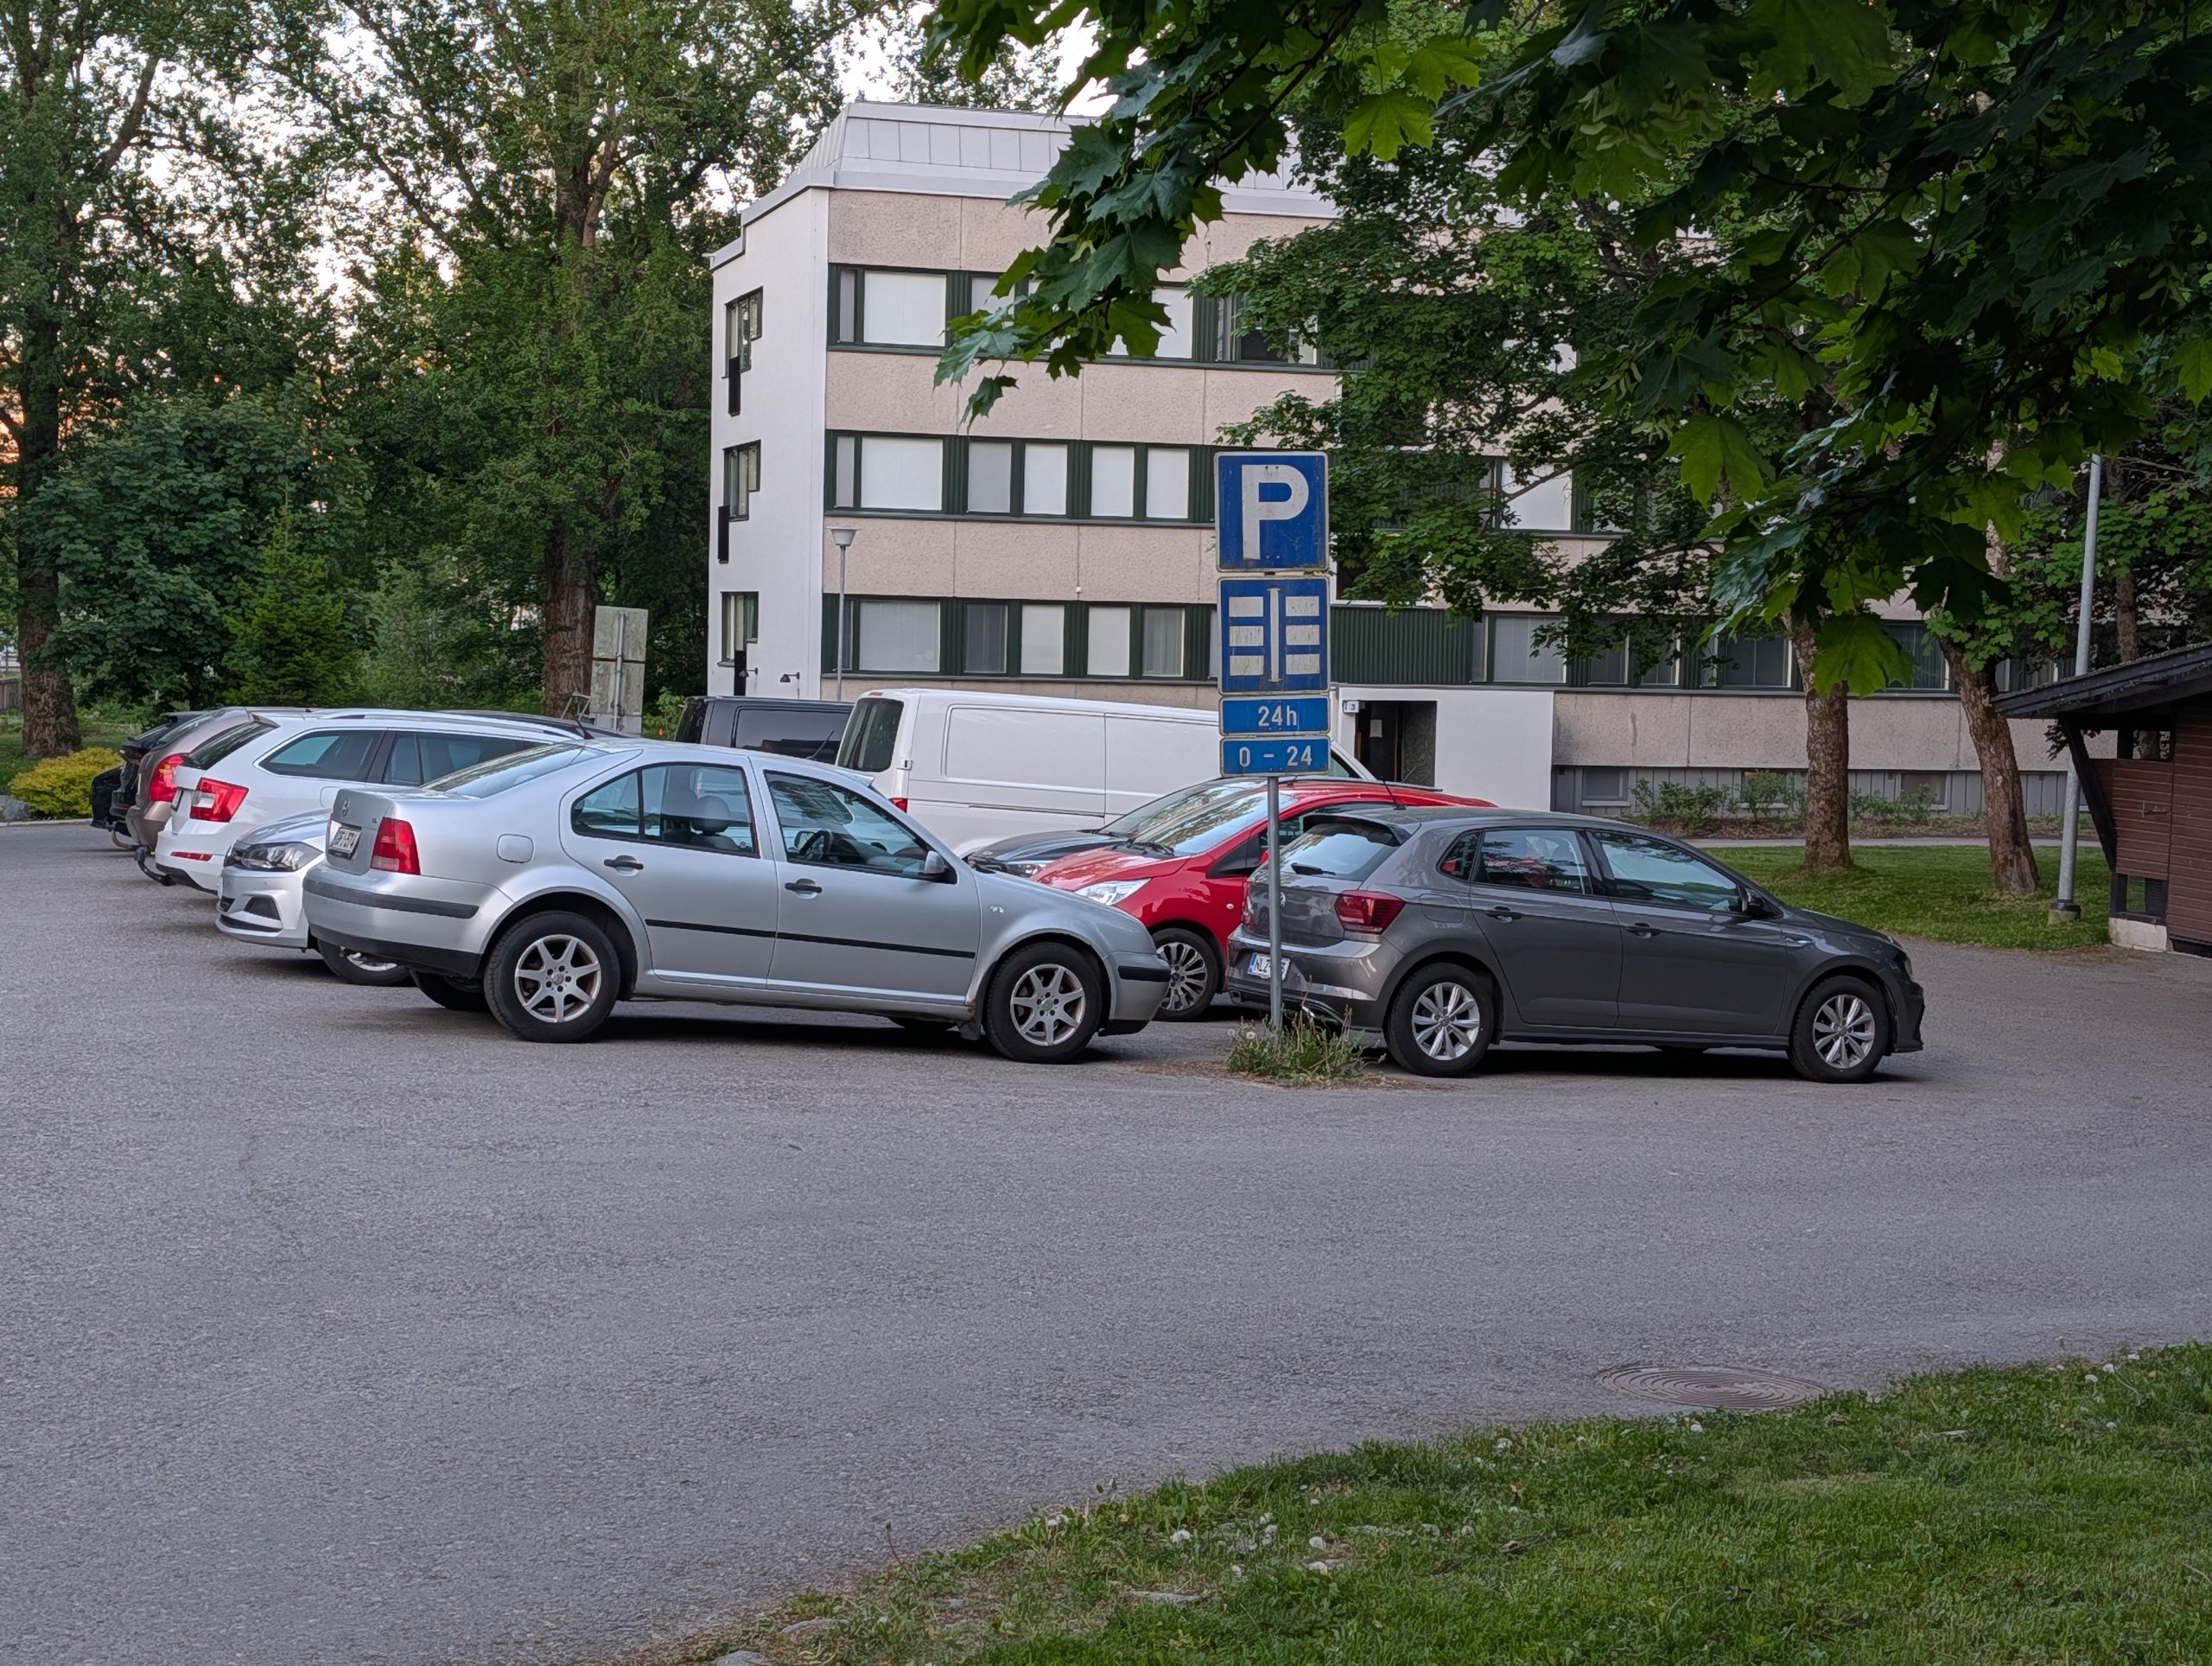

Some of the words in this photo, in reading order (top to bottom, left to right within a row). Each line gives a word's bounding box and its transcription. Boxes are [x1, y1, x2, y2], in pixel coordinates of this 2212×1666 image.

[1242, 464, 1309, 560] P
[1258, 704, 1298, 727] 24h
[1239, 746, 1251, 767] 0
[1287, 745, 1313, 766] 24
